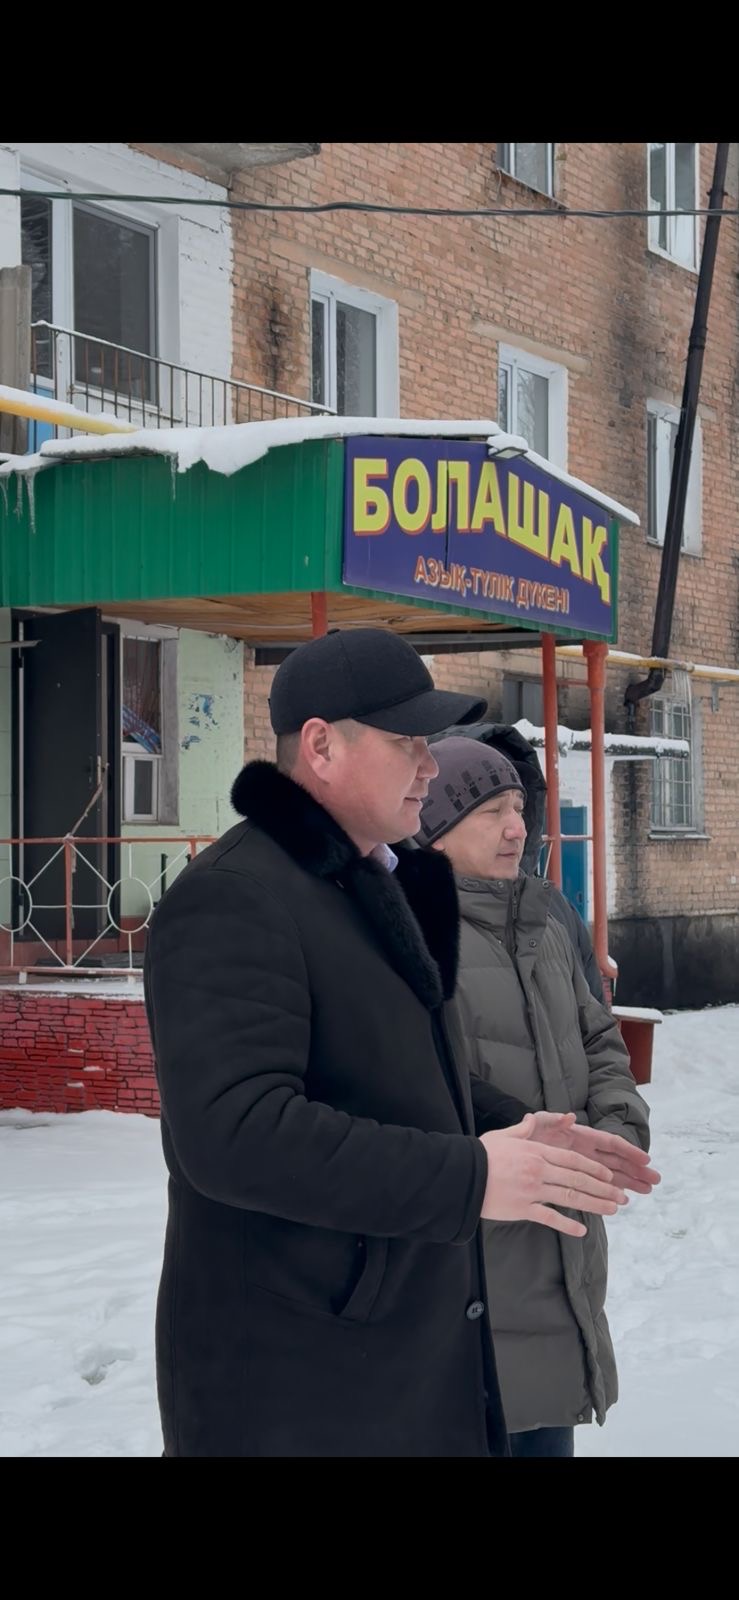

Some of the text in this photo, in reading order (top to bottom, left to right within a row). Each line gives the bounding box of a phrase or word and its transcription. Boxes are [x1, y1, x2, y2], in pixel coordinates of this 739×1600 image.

[352, 457, 611, 606] БОЛАШАҚ
[414, 555, 570, 614] АЗЫҚ-ТҮЛІК ДҮКЕНІ
